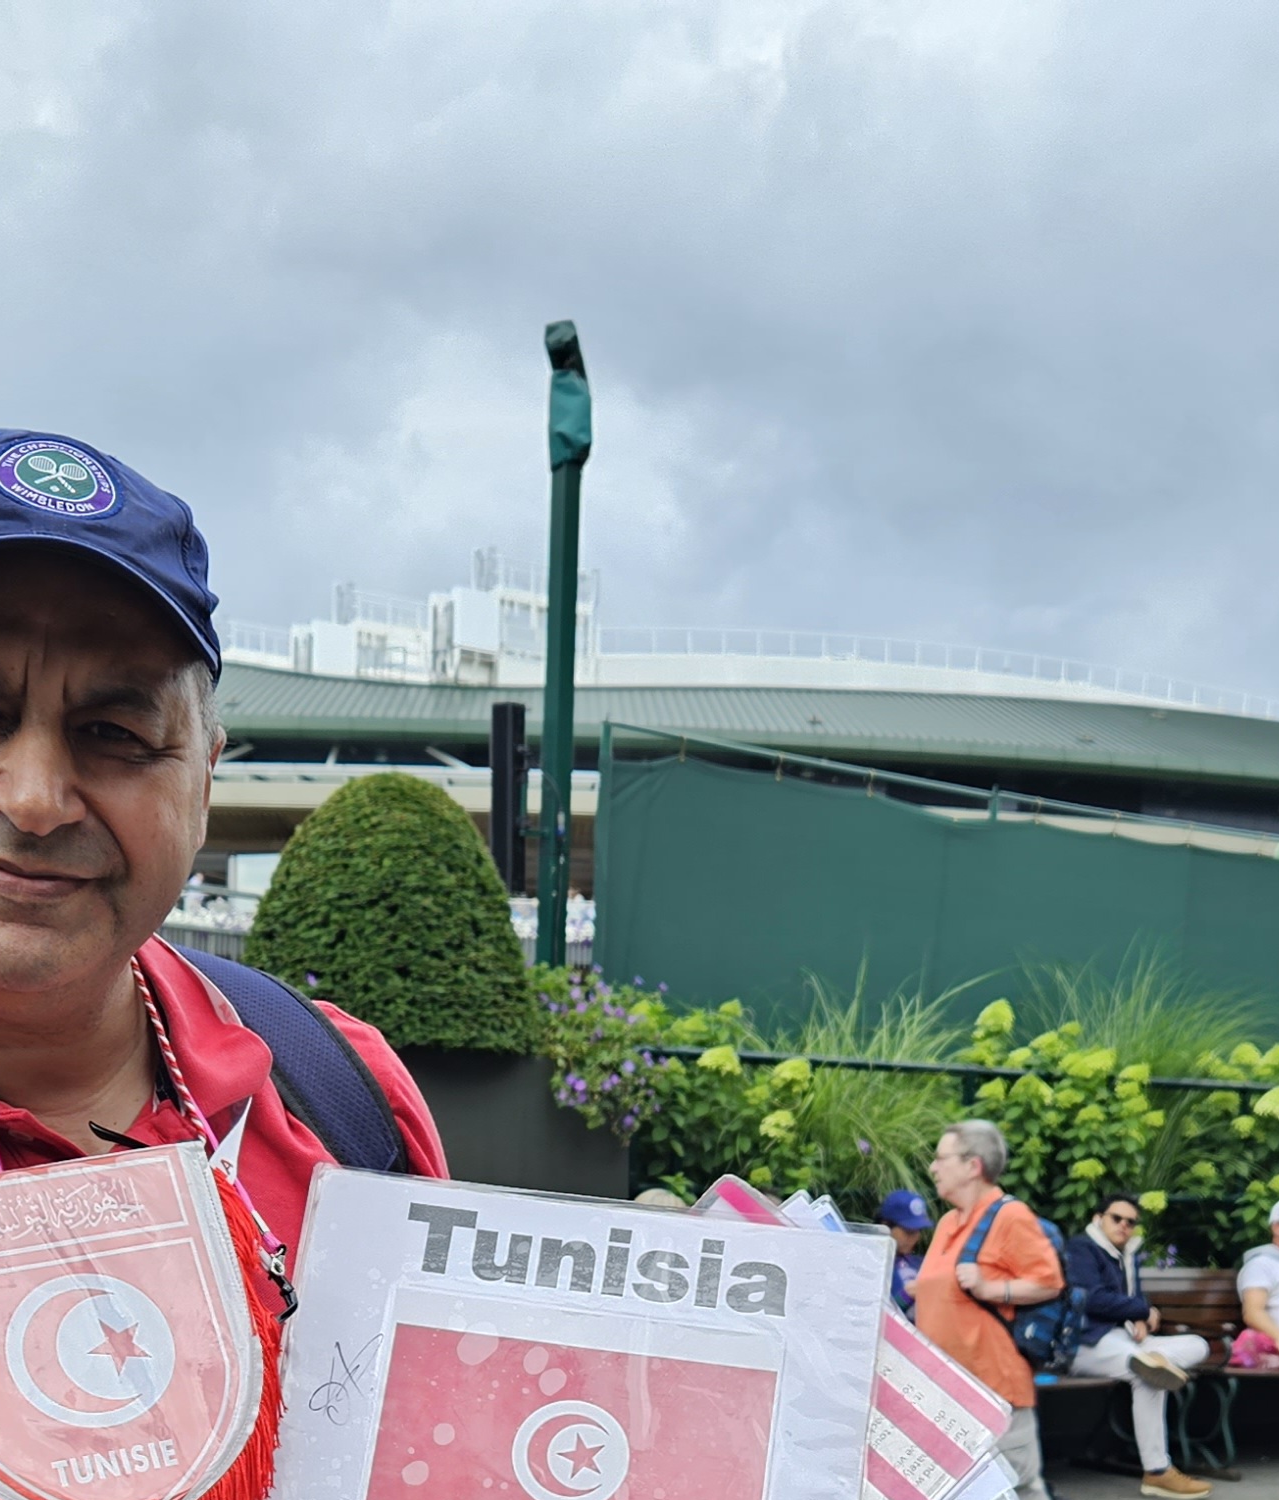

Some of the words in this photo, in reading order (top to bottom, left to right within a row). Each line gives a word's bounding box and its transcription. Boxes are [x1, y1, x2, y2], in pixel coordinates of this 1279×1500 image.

[1, 452, 22, 468] THE
[10, 483, 96, 512] WIMBLEDON
[408, 1202, 789, 1318] Tunisia
[50, 1439, 179, 1488] TUNISIE
